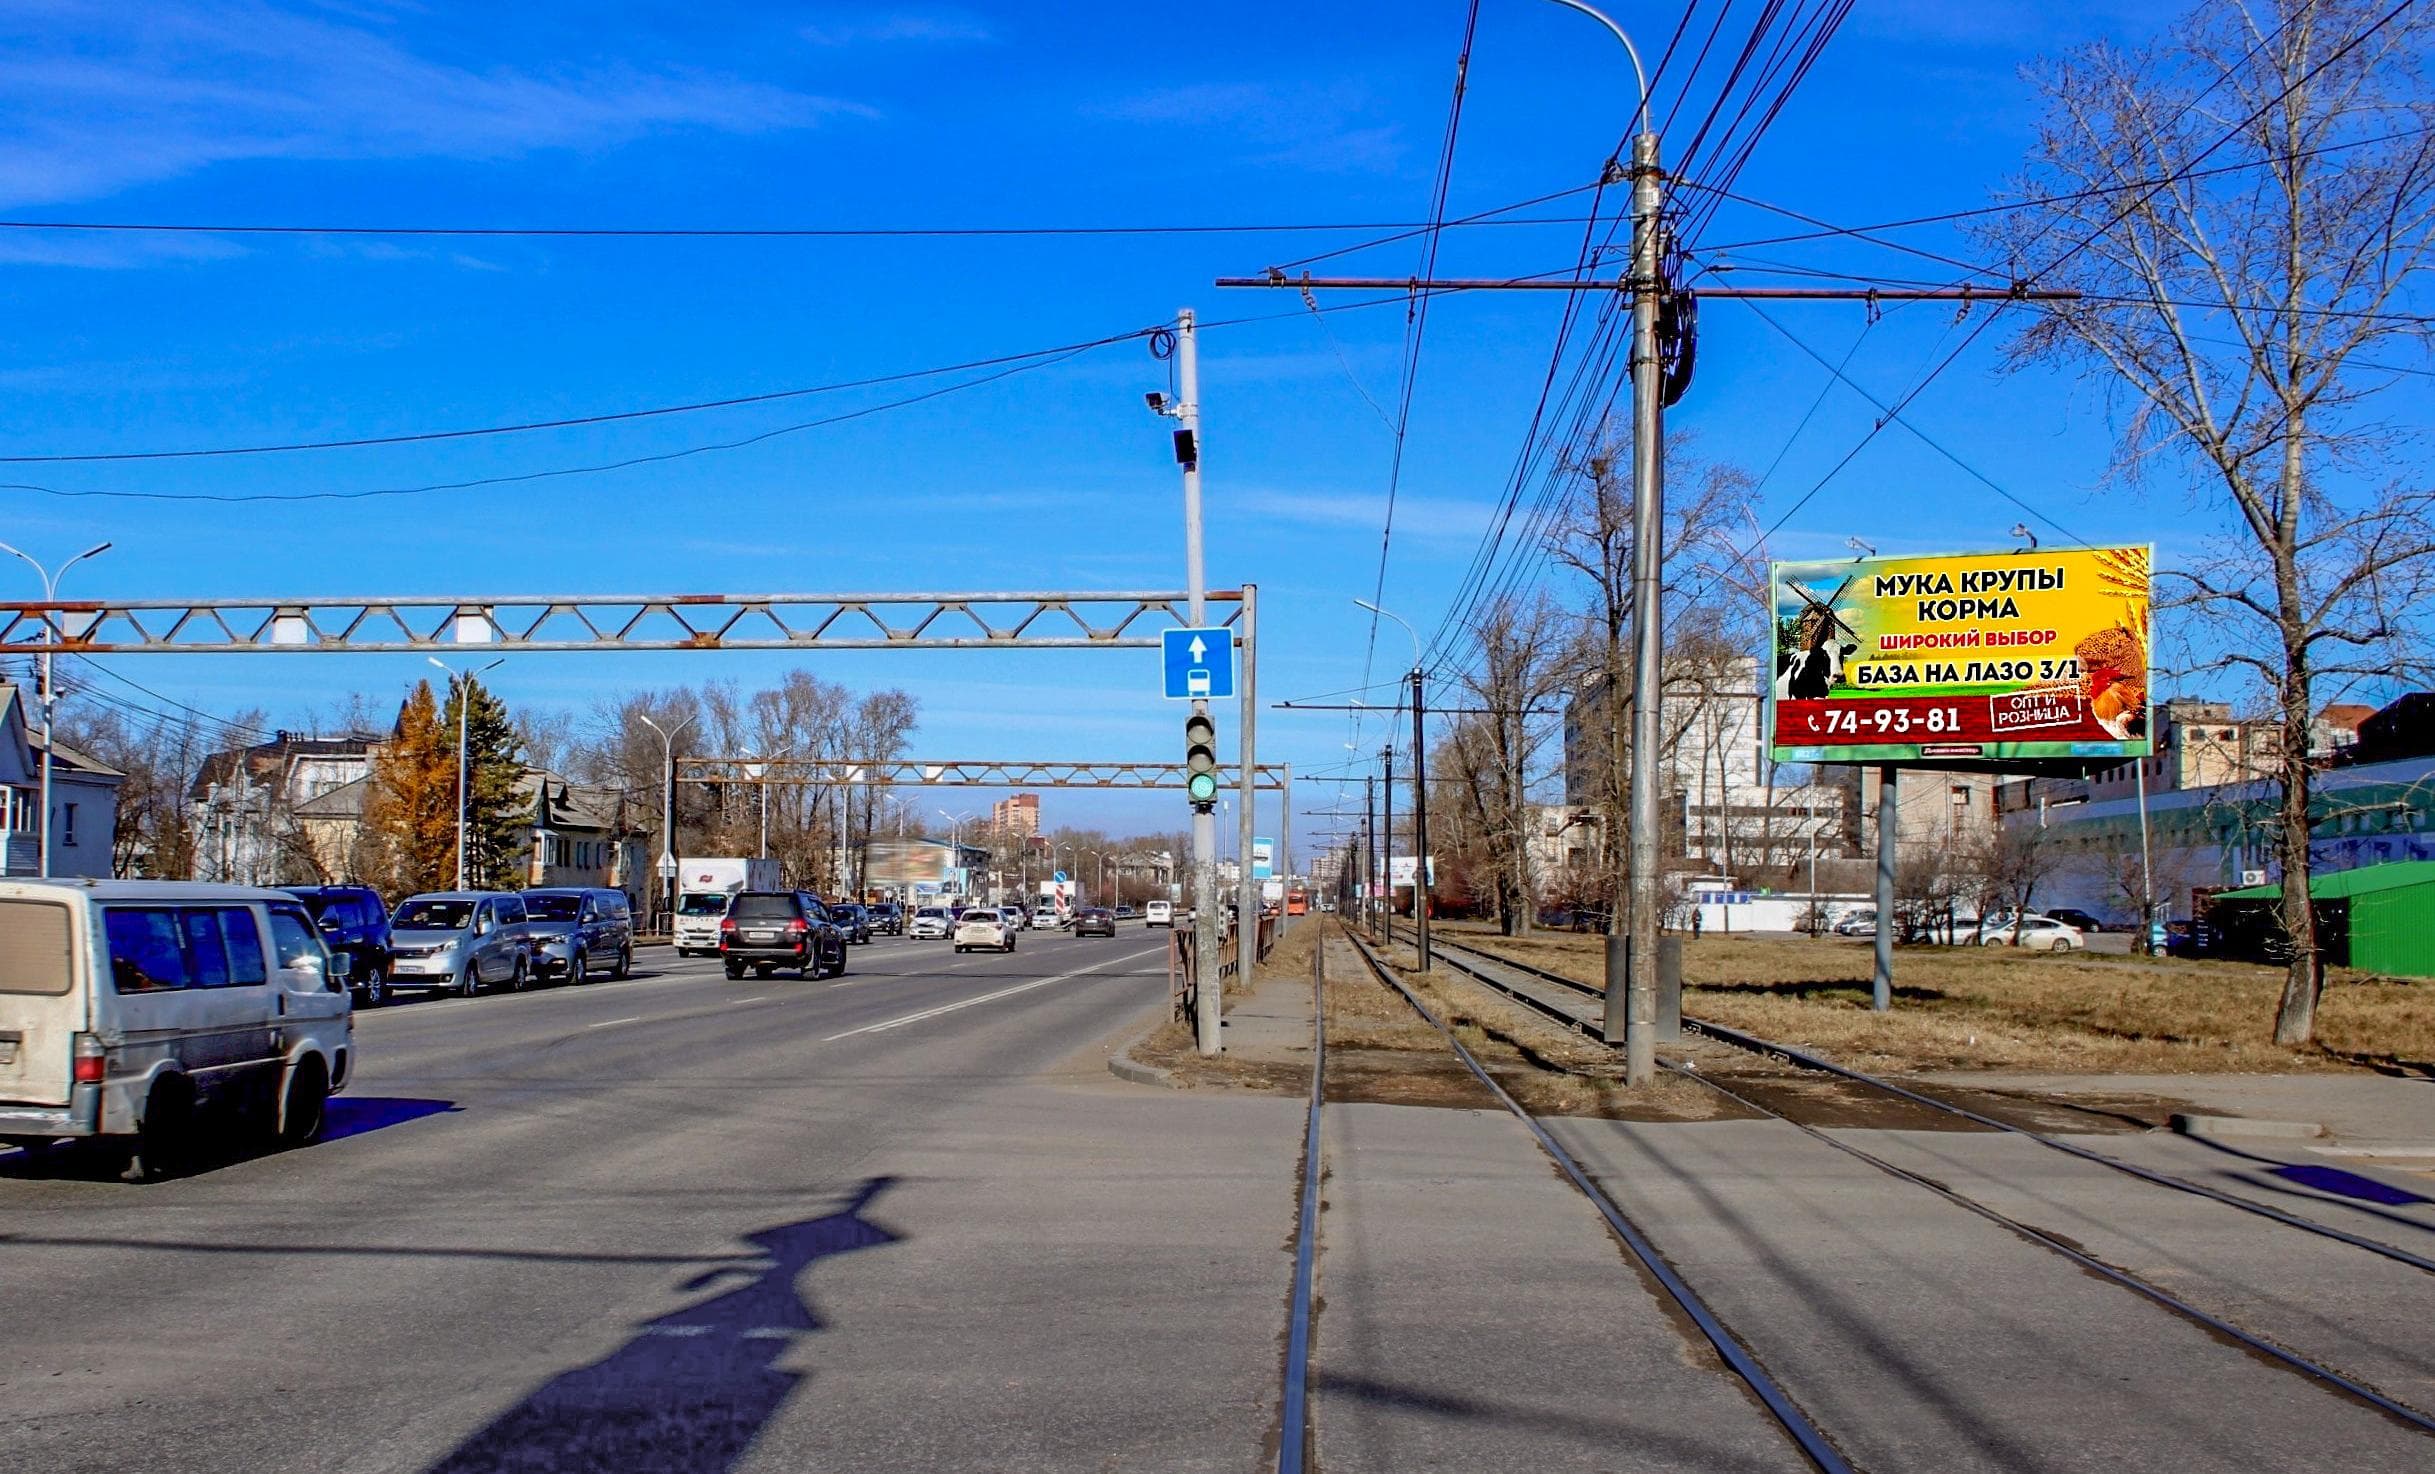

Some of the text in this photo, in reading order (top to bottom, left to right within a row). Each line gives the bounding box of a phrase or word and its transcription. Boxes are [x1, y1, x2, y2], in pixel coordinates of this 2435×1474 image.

[1876, 568, 2064, 597] МУКА КРУПЫ
[1918, 597, 2019, 622] КОРМА
[1880, 629, 2057, 650] ШИРОКИЙ ВЫБОР
[1858, 660, 2080, 684] БАЗА НА ЛАЗО 3/1
[2010, 694, 2056, 710] ОПТ И
[1825, 707, 1961, 734] 74-93-81
[1998, 705, 2070, 725] РОЗНИЦА
